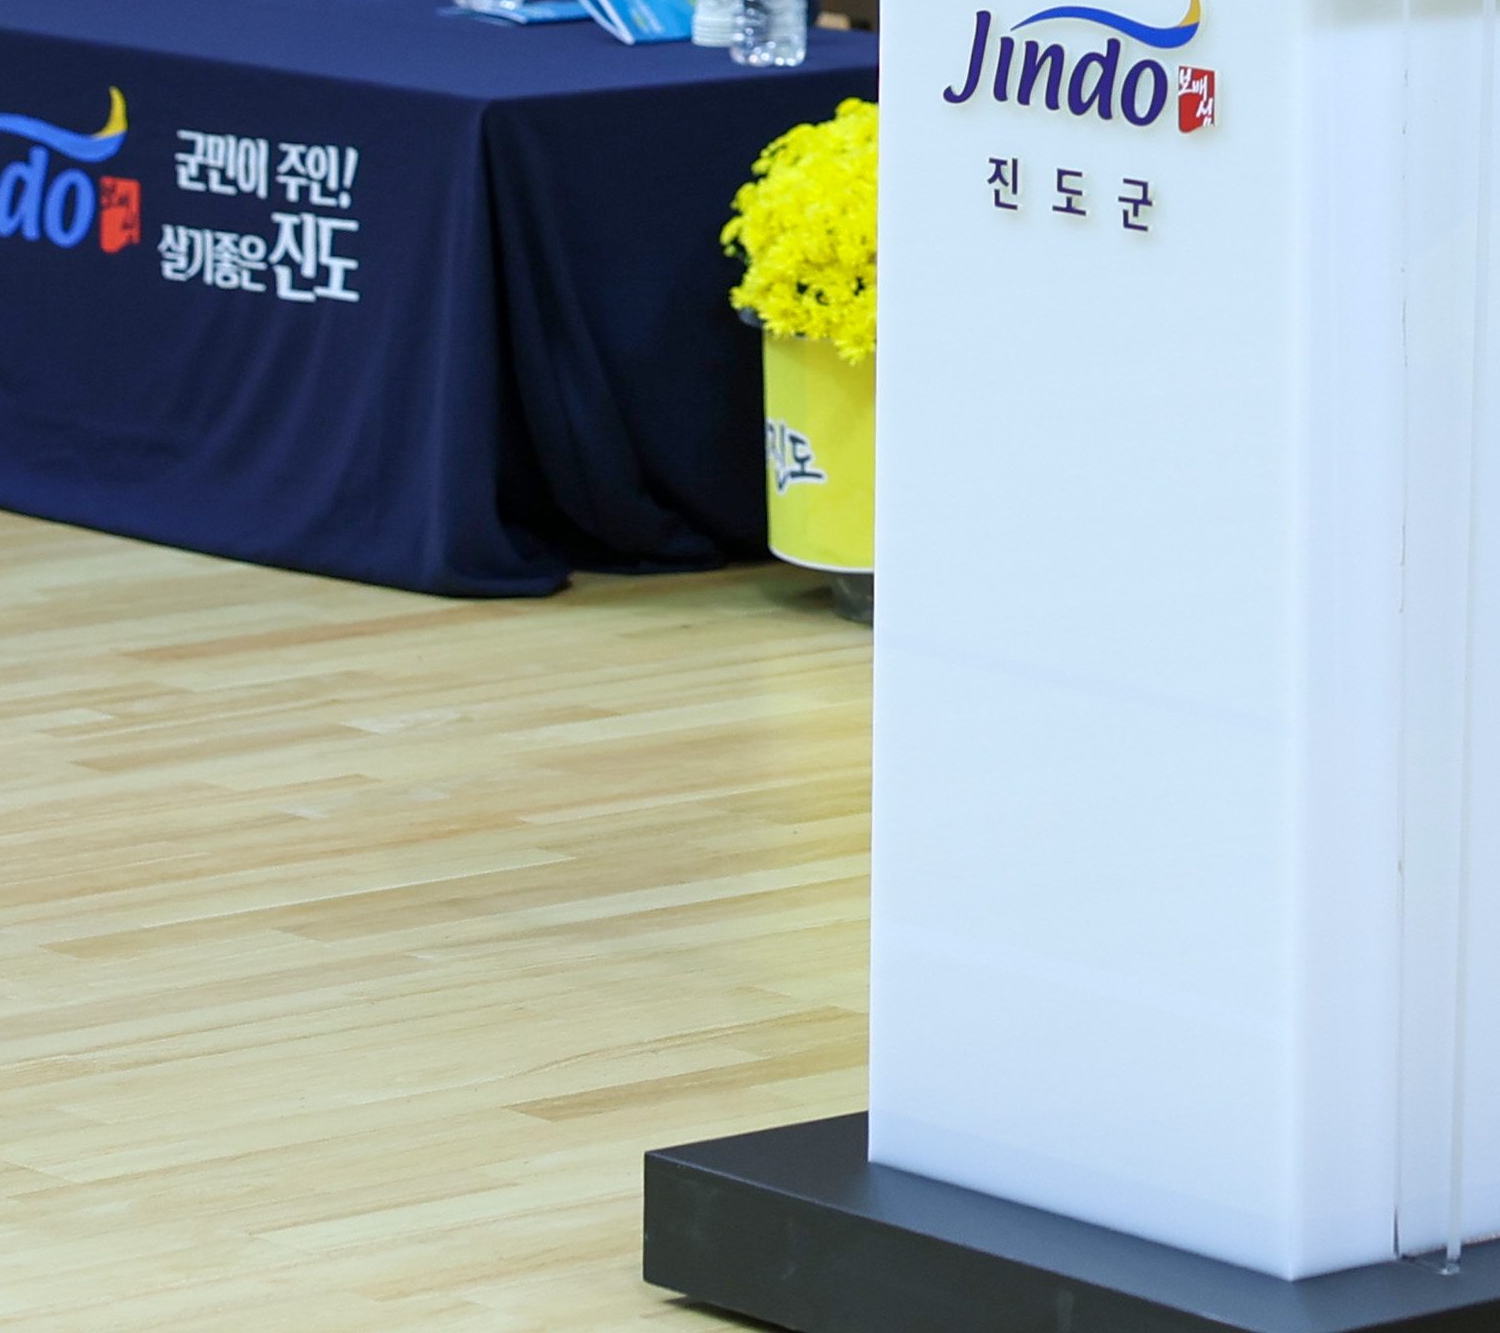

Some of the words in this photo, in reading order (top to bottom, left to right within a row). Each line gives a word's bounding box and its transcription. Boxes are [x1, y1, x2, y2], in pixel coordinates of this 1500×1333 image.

[942, 9, 1169, 127] Jindo
[174, 129, 269, 200] 군민이
[275, 142, 359, 209] 주인!
[156, 223, 268, 292] 살기좋은
[267, 211, 360, 303] 진도
